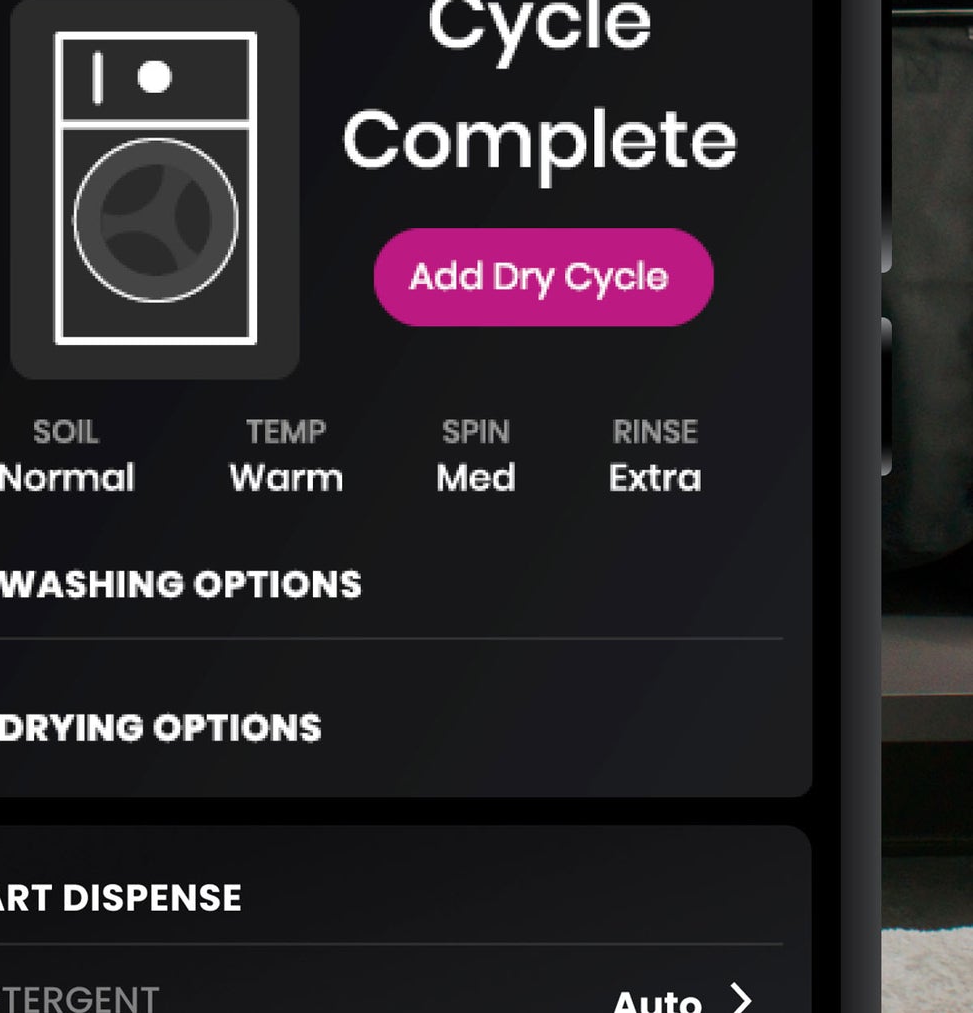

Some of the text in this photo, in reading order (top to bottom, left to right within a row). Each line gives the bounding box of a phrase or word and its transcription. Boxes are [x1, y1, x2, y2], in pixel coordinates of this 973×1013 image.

[342, 106, 738, 191] Complete
[407, 258, 670, 302] Add Dry Cycle
[32, 417, 100, 445] SOIL
[245, 417, 328, 445] TEMP
[441, 417, 511, 445] SPIN
[612, 417, 700, 445] RINSE
[229, 462, 344, 493] Warm
[436, 460, 516, 493] Med
[609, 462, 703, 493] Extra
[192, 568, 363, 600] OPTIONS
[152, 712, 323, 744] OPTIONS
[62, 882, 243, 913] DISPENSE
[612, 990, 704, 1013] Auto
